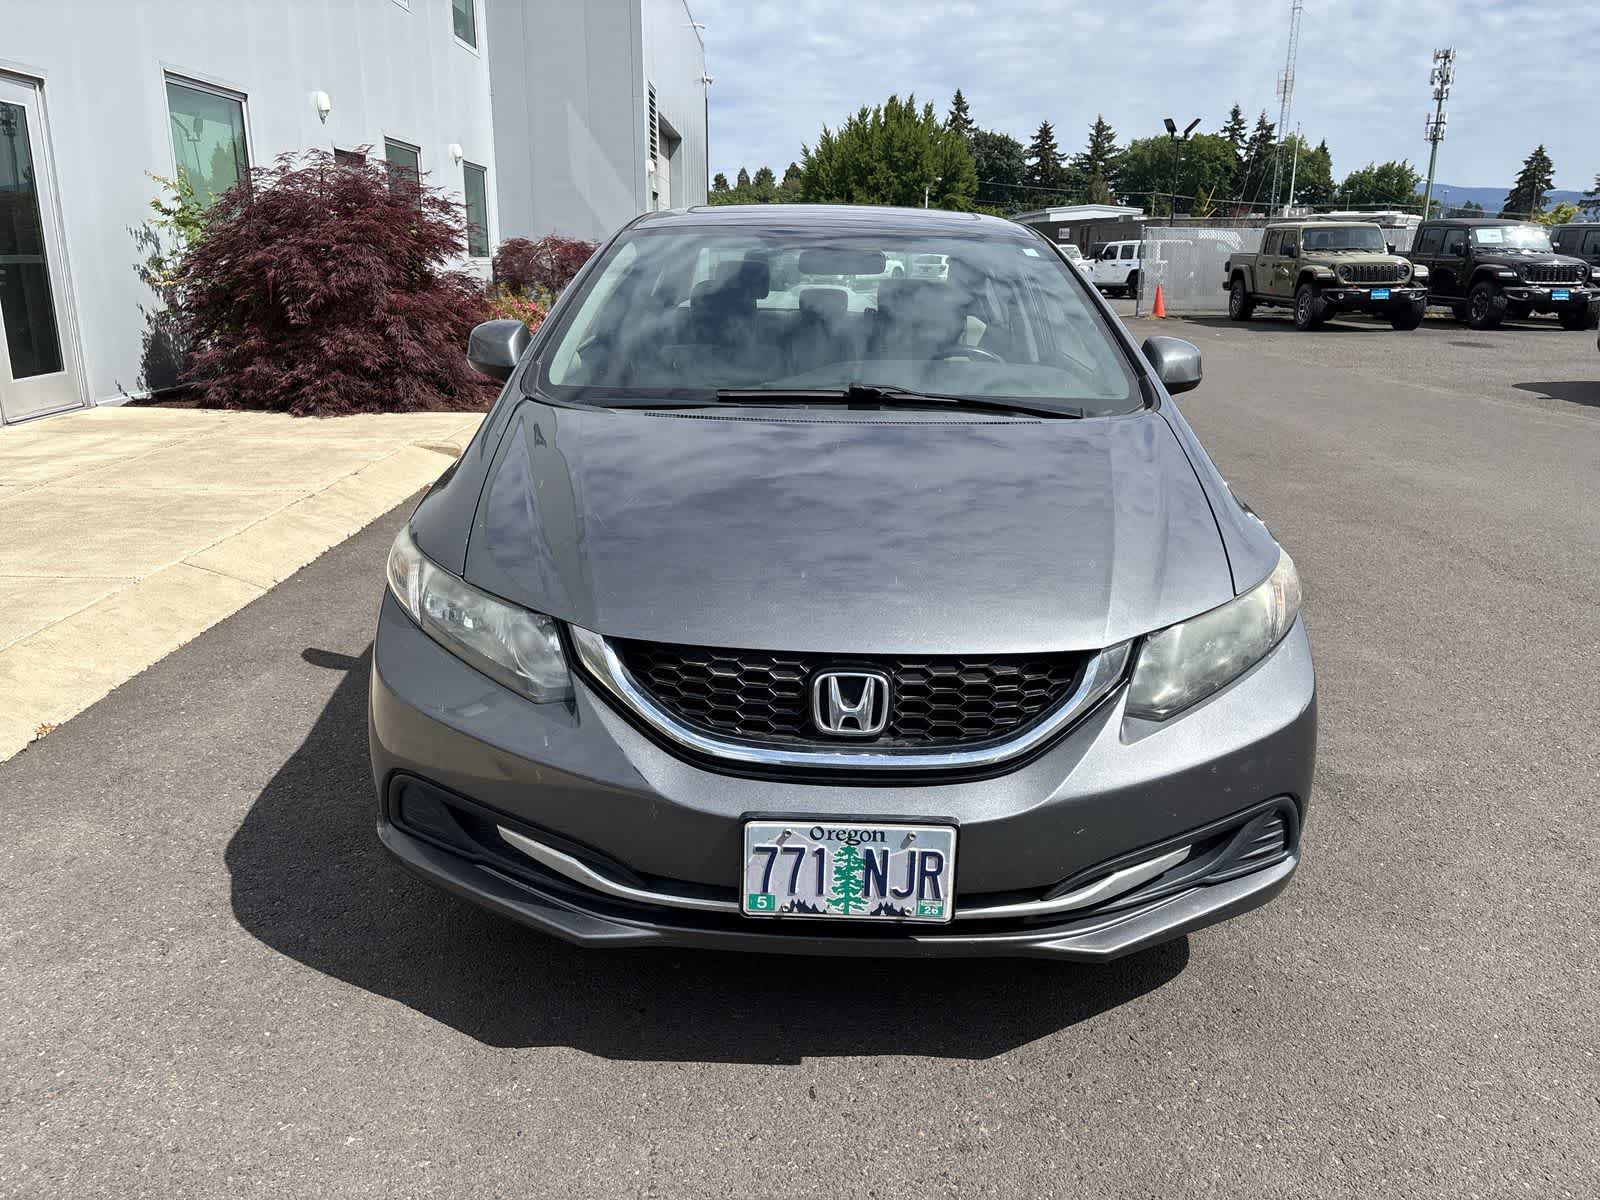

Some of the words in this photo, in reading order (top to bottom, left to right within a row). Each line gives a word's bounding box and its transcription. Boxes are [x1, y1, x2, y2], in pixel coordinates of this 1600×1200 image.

[810, 826, 887, 845] Oregon
[753, 846, 825, 896] 771
[863, 848, 944, 900] NJR
[757, 896, 767, 908] 5
[924, 907, 938, 915] 26
